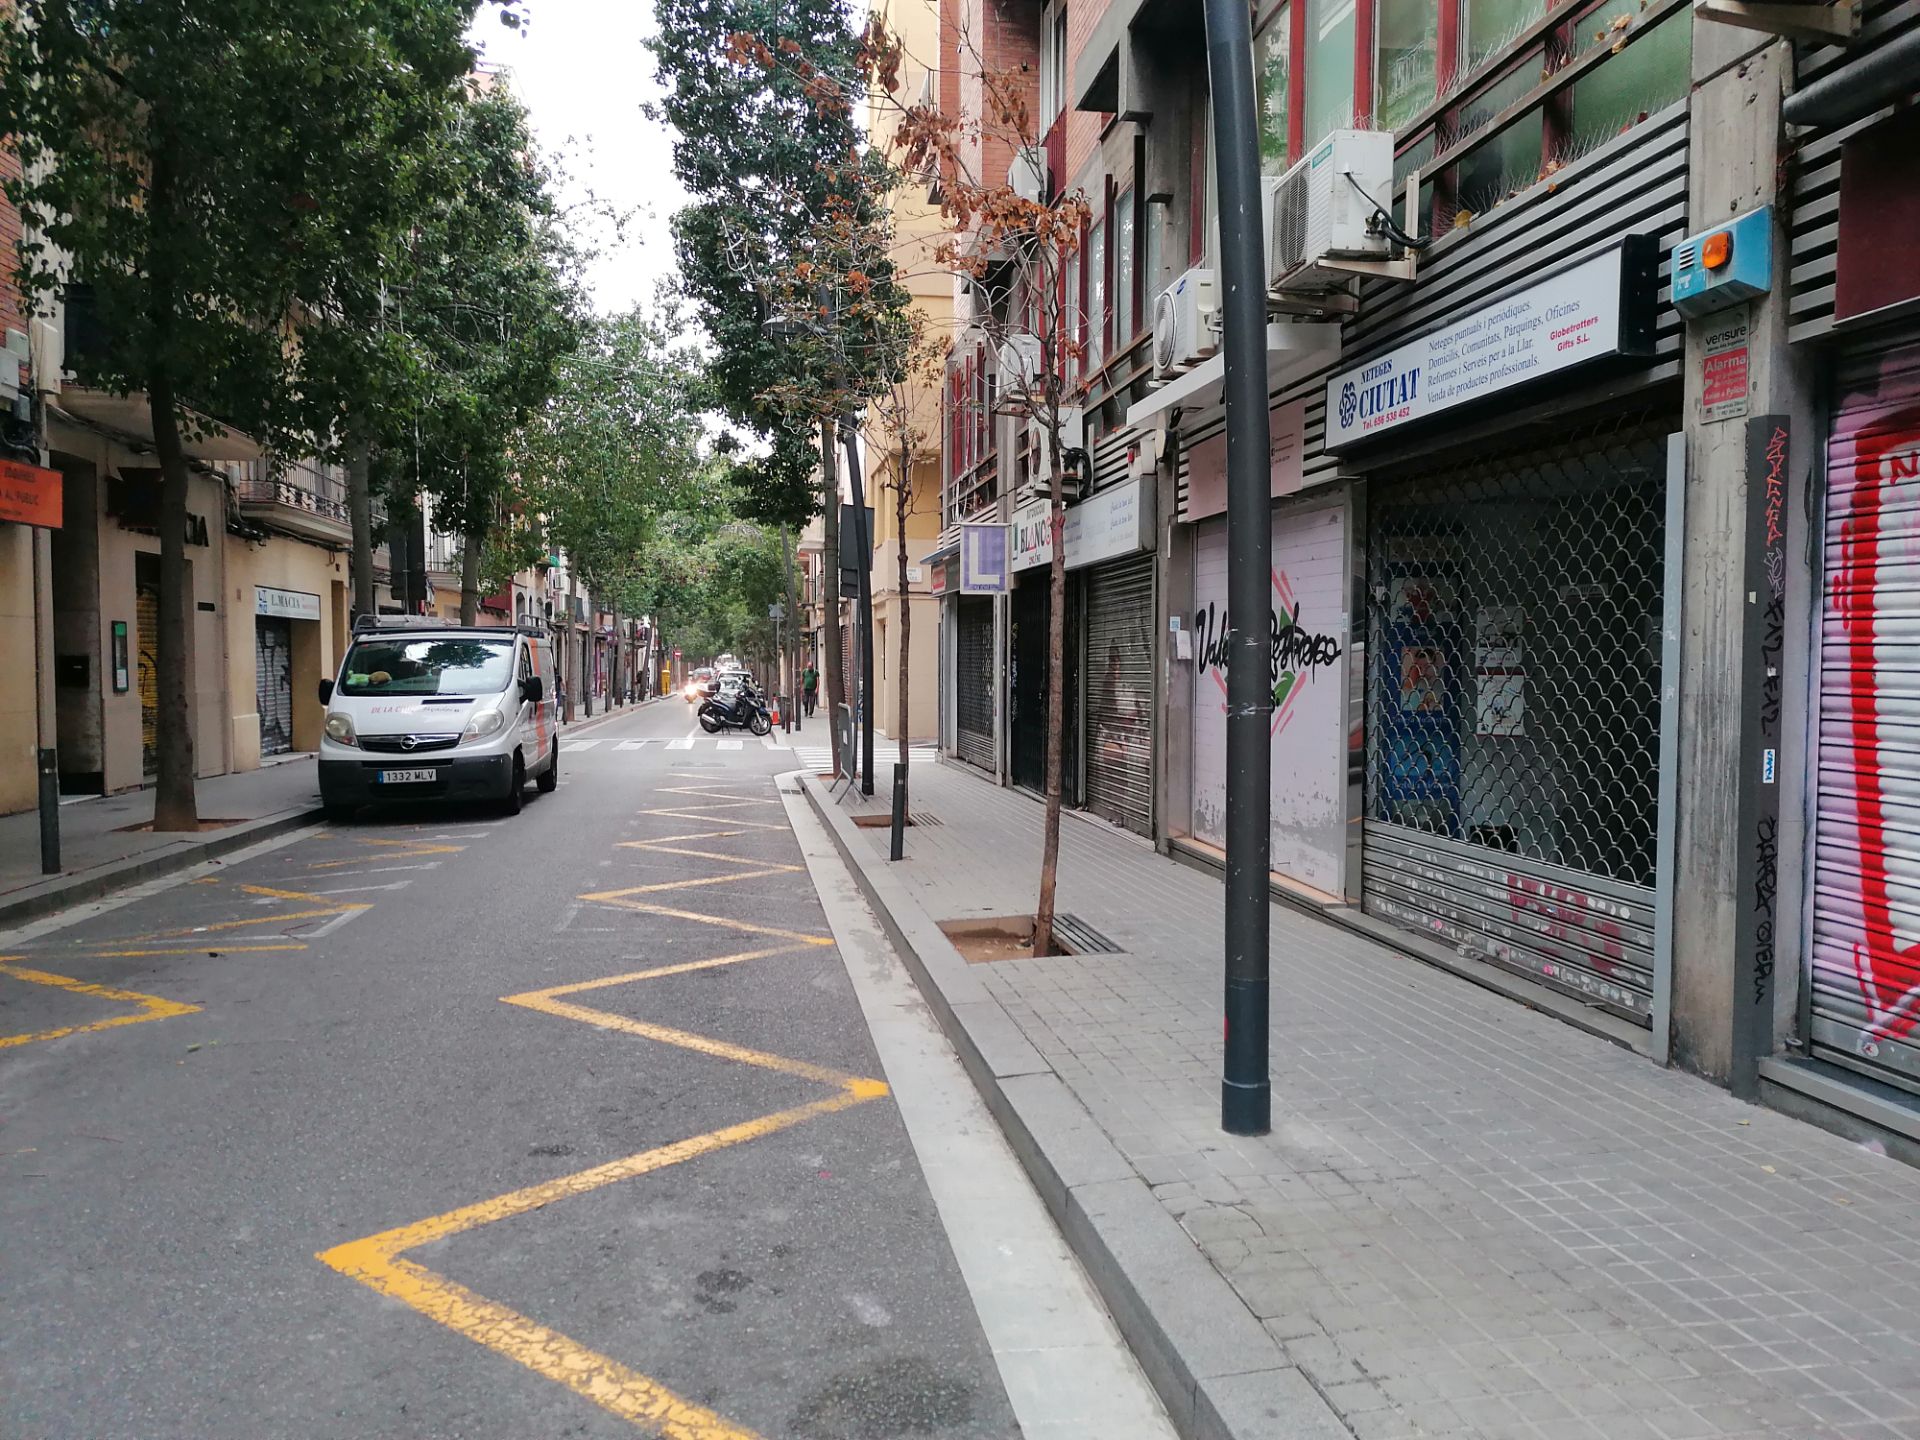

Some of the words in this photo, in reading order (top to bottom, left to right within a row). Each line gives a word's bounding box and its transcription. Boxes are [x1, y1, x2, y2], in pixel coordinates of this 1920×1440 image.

[1545, 300, 1580, 322] Oficines
[1454, 319, 1482, 344] puntuals
[1550, 316, 1599, 340] Globetrotters
[1705, 325, 1747, 346] verisure
[1557, 339, 1575, 352] Gifts
[1361, 359, 1393, 384] NETEGES
[1428, 368, 1457, 387] Reformes
[1462, 355, 1487, 374] Serveis
[1488, 351, 1499, 367] per
[1508, 344, 1515, 356] la
[1705, 356, 1747, 374] Alarma
[1359, 367, 1420, 419] CIUTAT
[1427, 387, 1446, 404] Venda
[1447, 384, 1456, 397] de
[1456, 373, 1488, 397] productes
[387, 771, 412, 782] 1332
[414, 770, 434, 780] MLV
